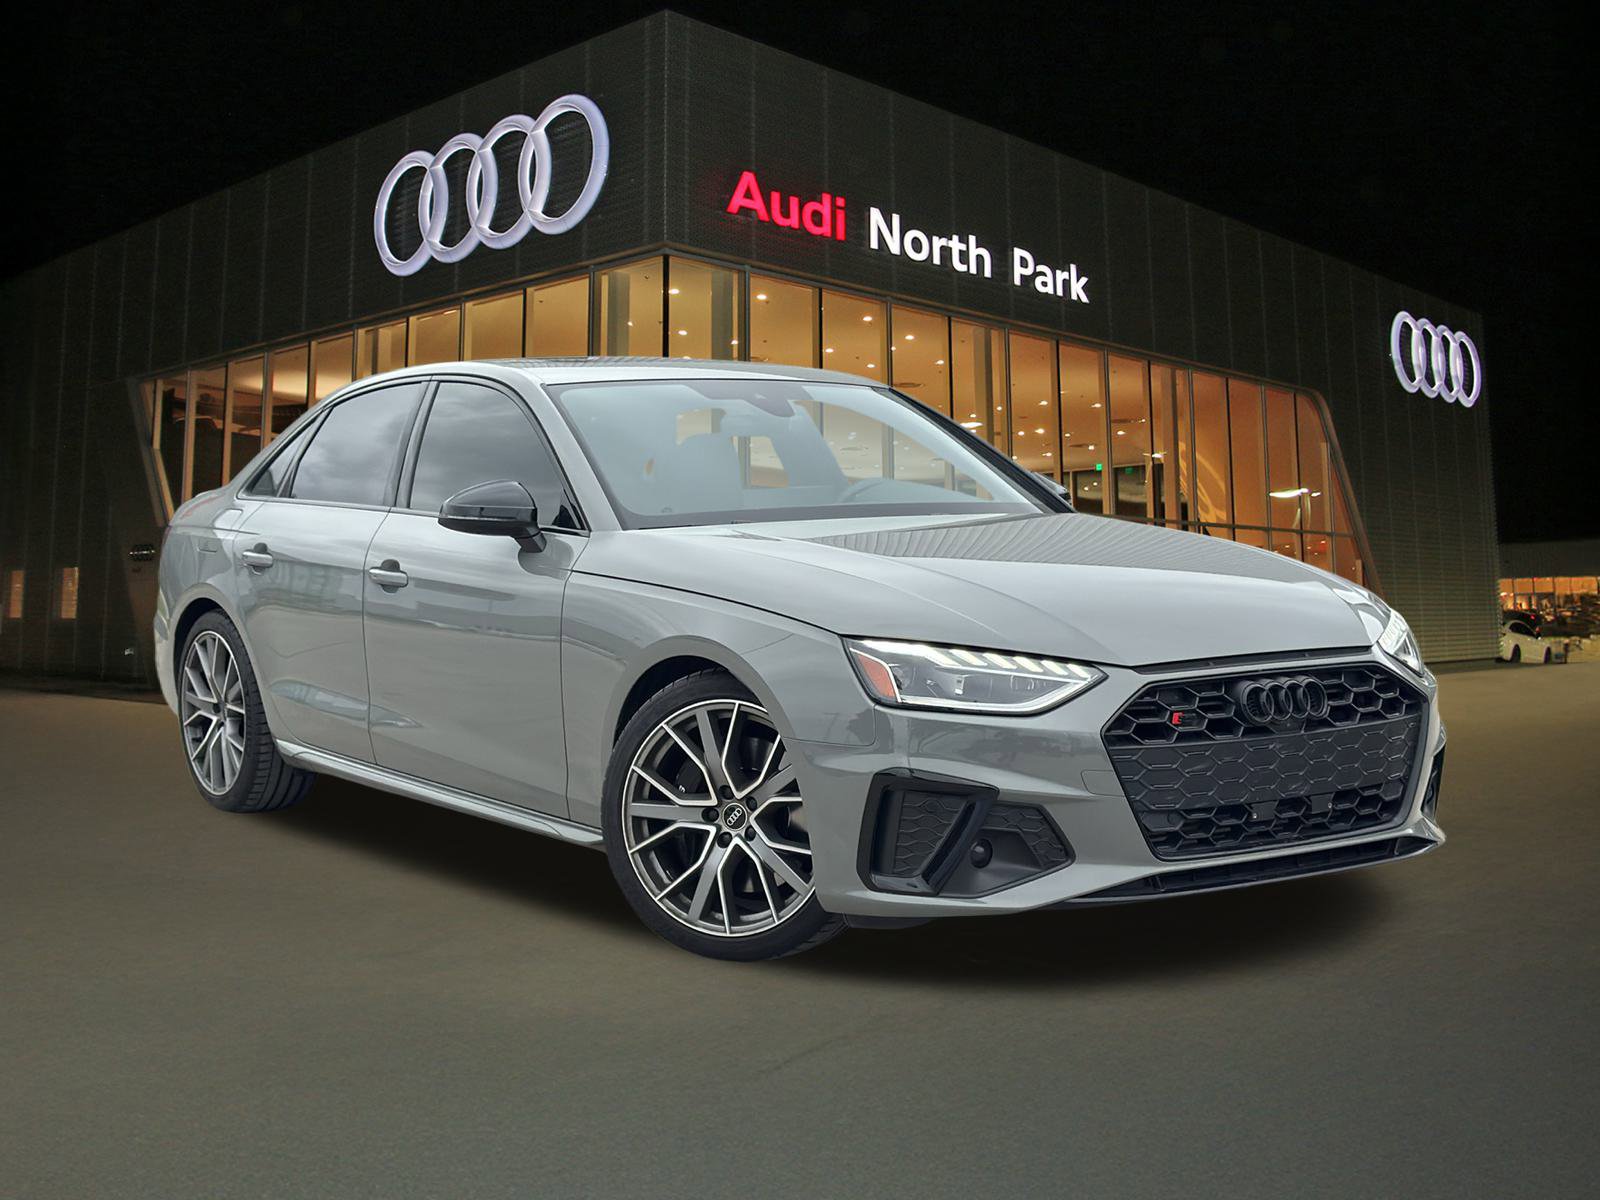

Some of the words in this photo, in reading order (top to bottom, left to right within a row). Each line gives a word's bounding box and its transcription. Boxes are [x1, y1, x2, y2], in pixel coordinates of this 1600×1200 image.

[726, 170, 846, 241] Audi
[869, 206, 992, 278] North
[1013, 246, 1090, 304] Park
